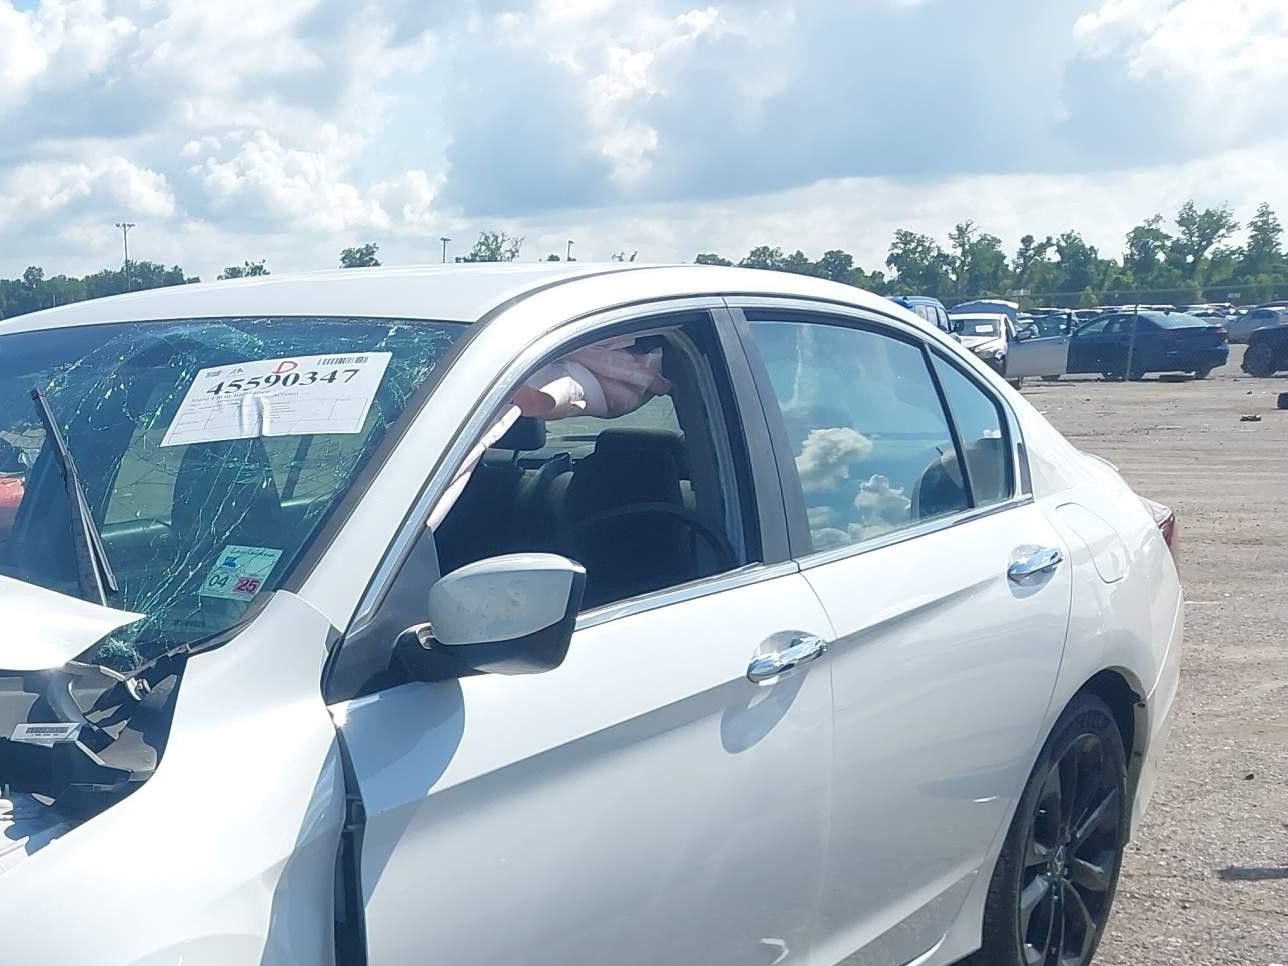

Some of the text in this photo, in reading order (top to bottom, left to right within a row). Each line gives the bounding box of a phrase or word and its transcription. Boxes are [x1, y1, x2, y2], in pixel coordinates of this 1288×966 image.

[272, 360, 299, 375] D
[206, 368, 361, 396] 45590347
[208, 575, 259, 592] 04 25
